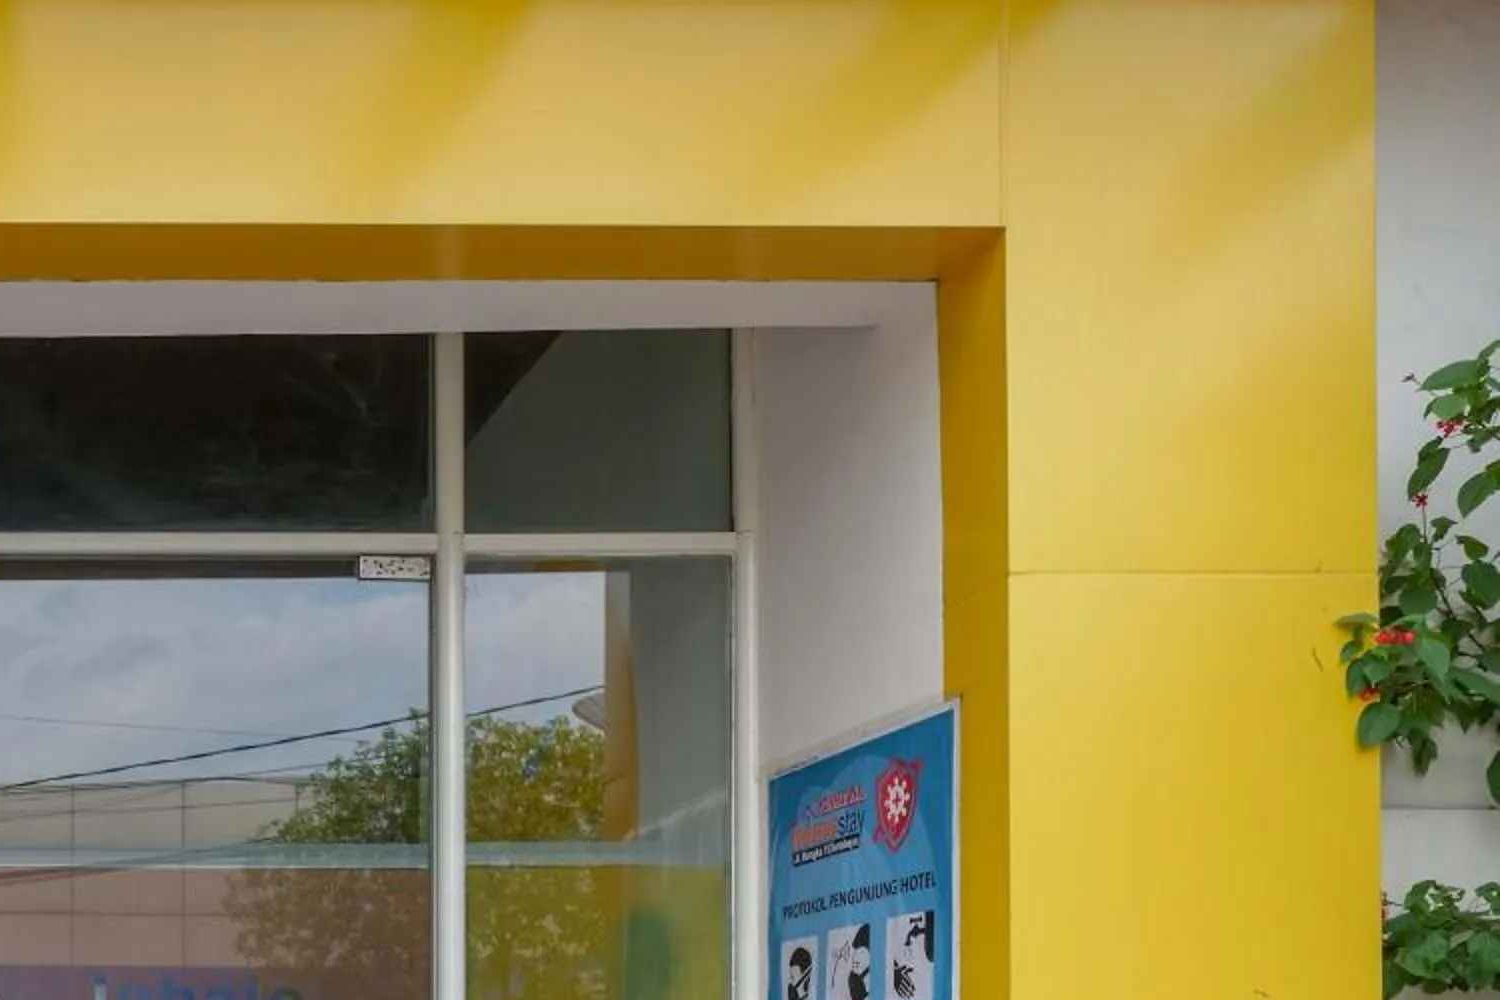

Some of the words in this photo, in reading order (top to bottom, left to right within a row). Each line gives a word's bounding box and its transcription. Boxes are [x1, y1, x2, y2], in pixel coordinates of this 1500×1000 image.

[782, 897, 827, 920] PROTOKOL
[829, 880, 898, 909] PENGUNJUNG
[900, 871, 937, 894] HOTEL
